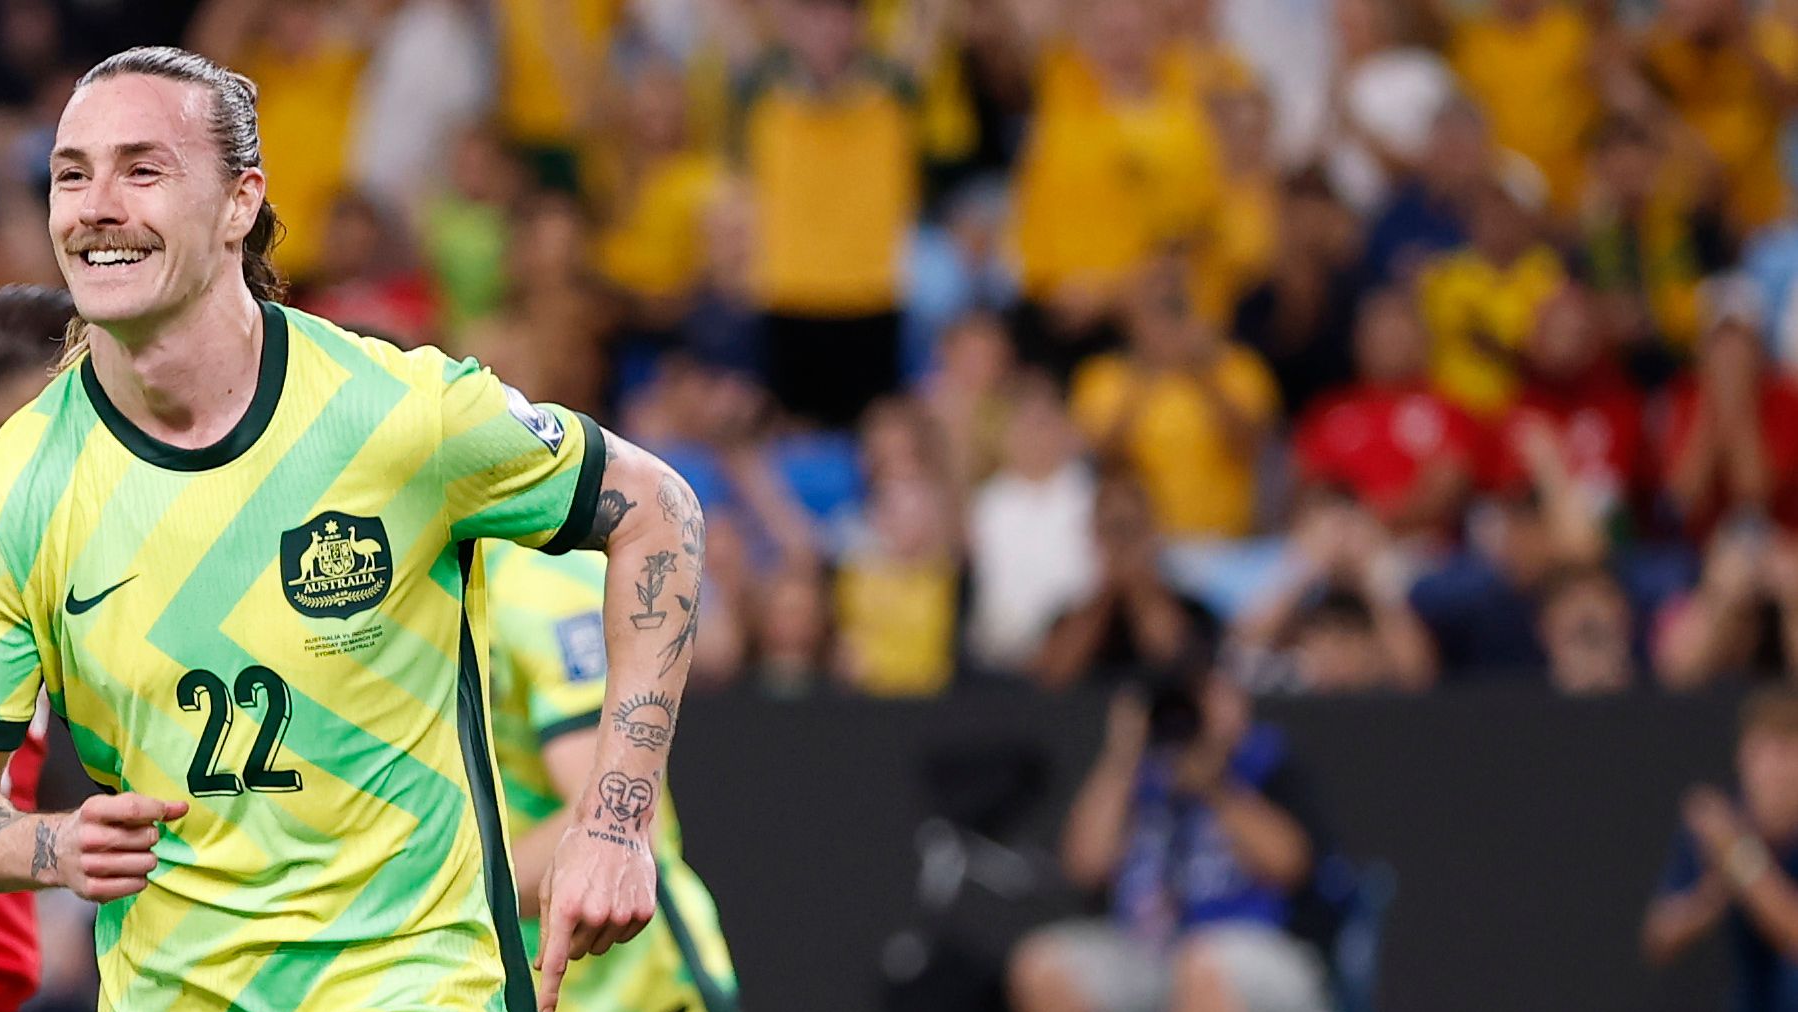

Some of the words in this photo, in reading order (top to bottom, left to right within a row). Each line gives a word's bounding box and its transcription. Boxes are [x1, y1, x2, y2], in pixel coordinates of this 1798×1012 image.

[303, 573, 376, 594] AUSTRALIA
[304, 633, 341, 645] AUSTRALIA
[304, 642, 339, 652] THURSDAY
[349, 634, 371, 645] MARCH
[344, 640, 376, 653] AUSTRALIA
[176, 665, 303, 798] 22
[609, 823, 627, 834] NO
